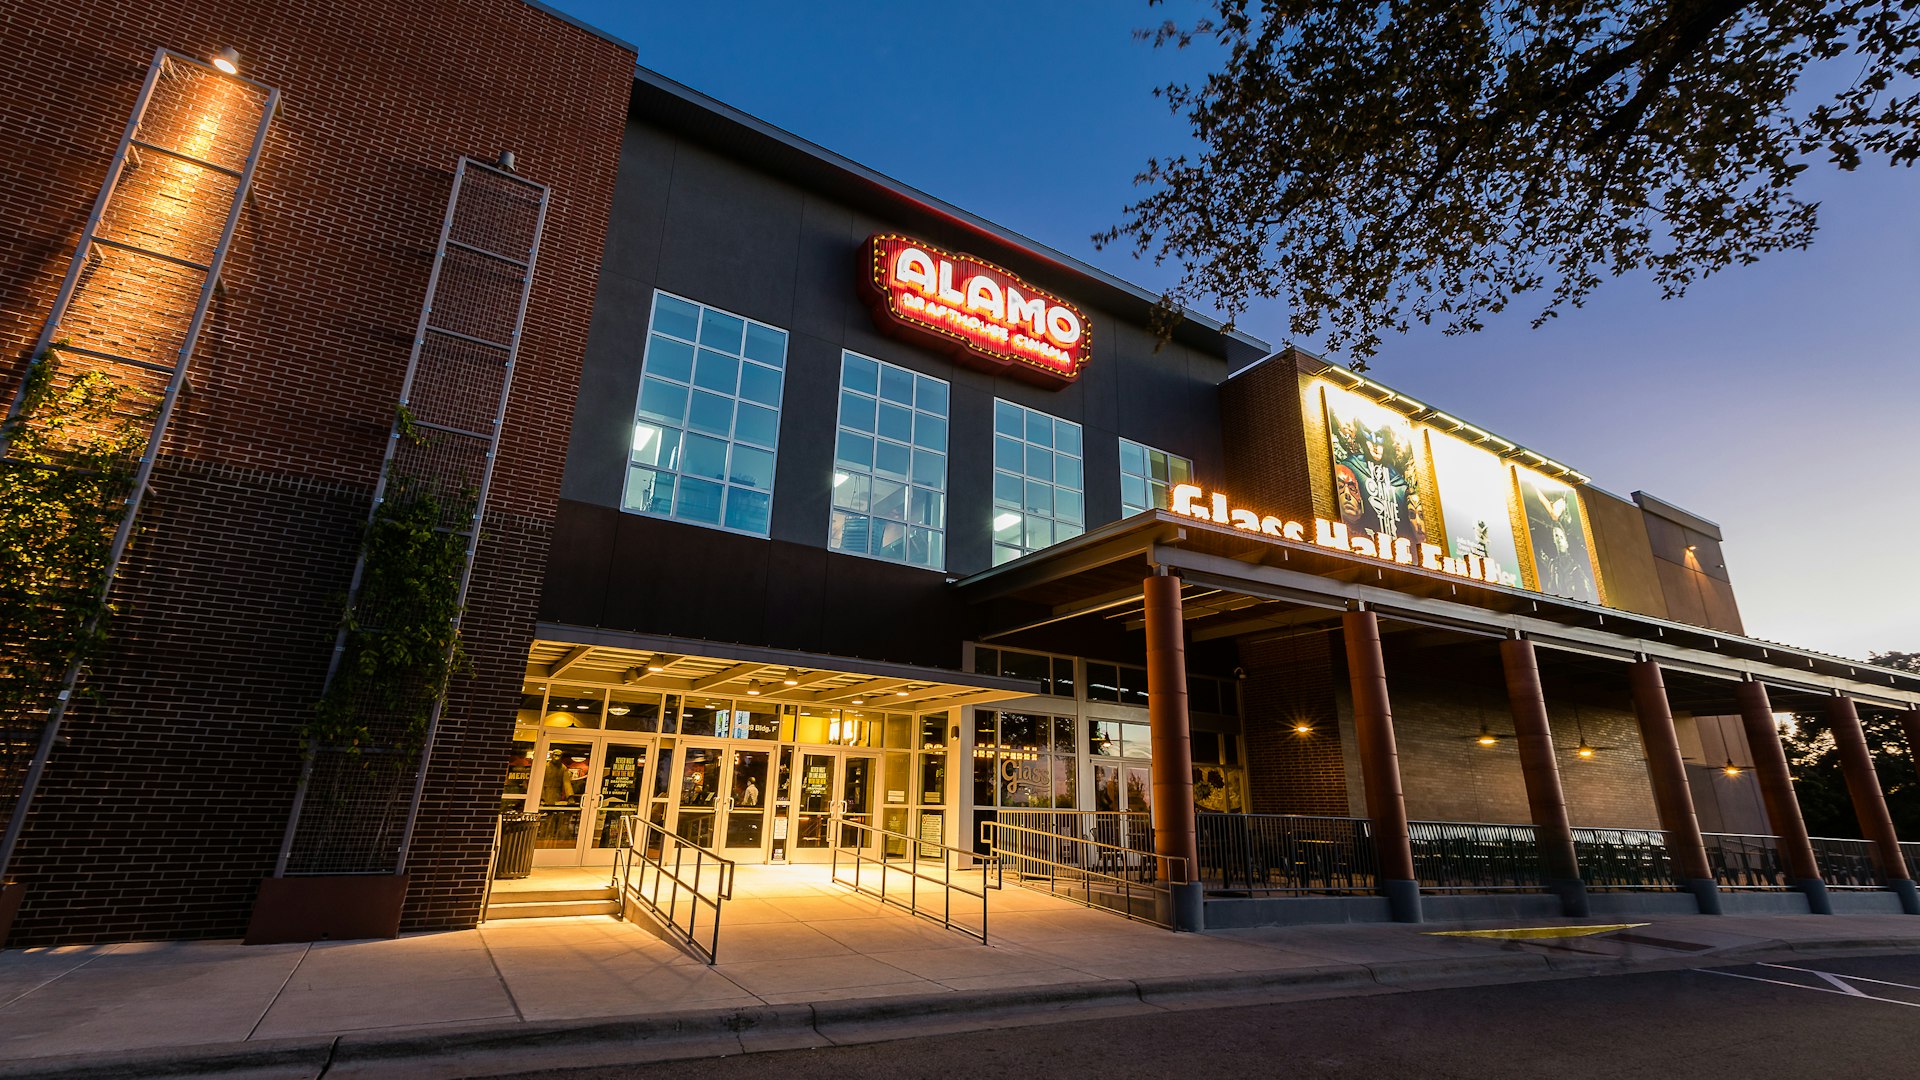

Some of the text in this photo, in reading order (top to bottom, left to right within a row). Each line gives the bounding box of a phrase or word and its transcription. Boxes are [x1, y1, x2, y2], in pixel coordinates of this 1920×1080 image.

[897, 248, 1080, 343] ALAMO
[902, 292, 1070, 363] DRAFTHOUSE CINEMA
[1172, 483, 1304, 542] Glass
[1313, 517, 1413, 565] Half
[1421, 542, 1498, 584] Full
[1002, 759, 1049, 794] Glass
